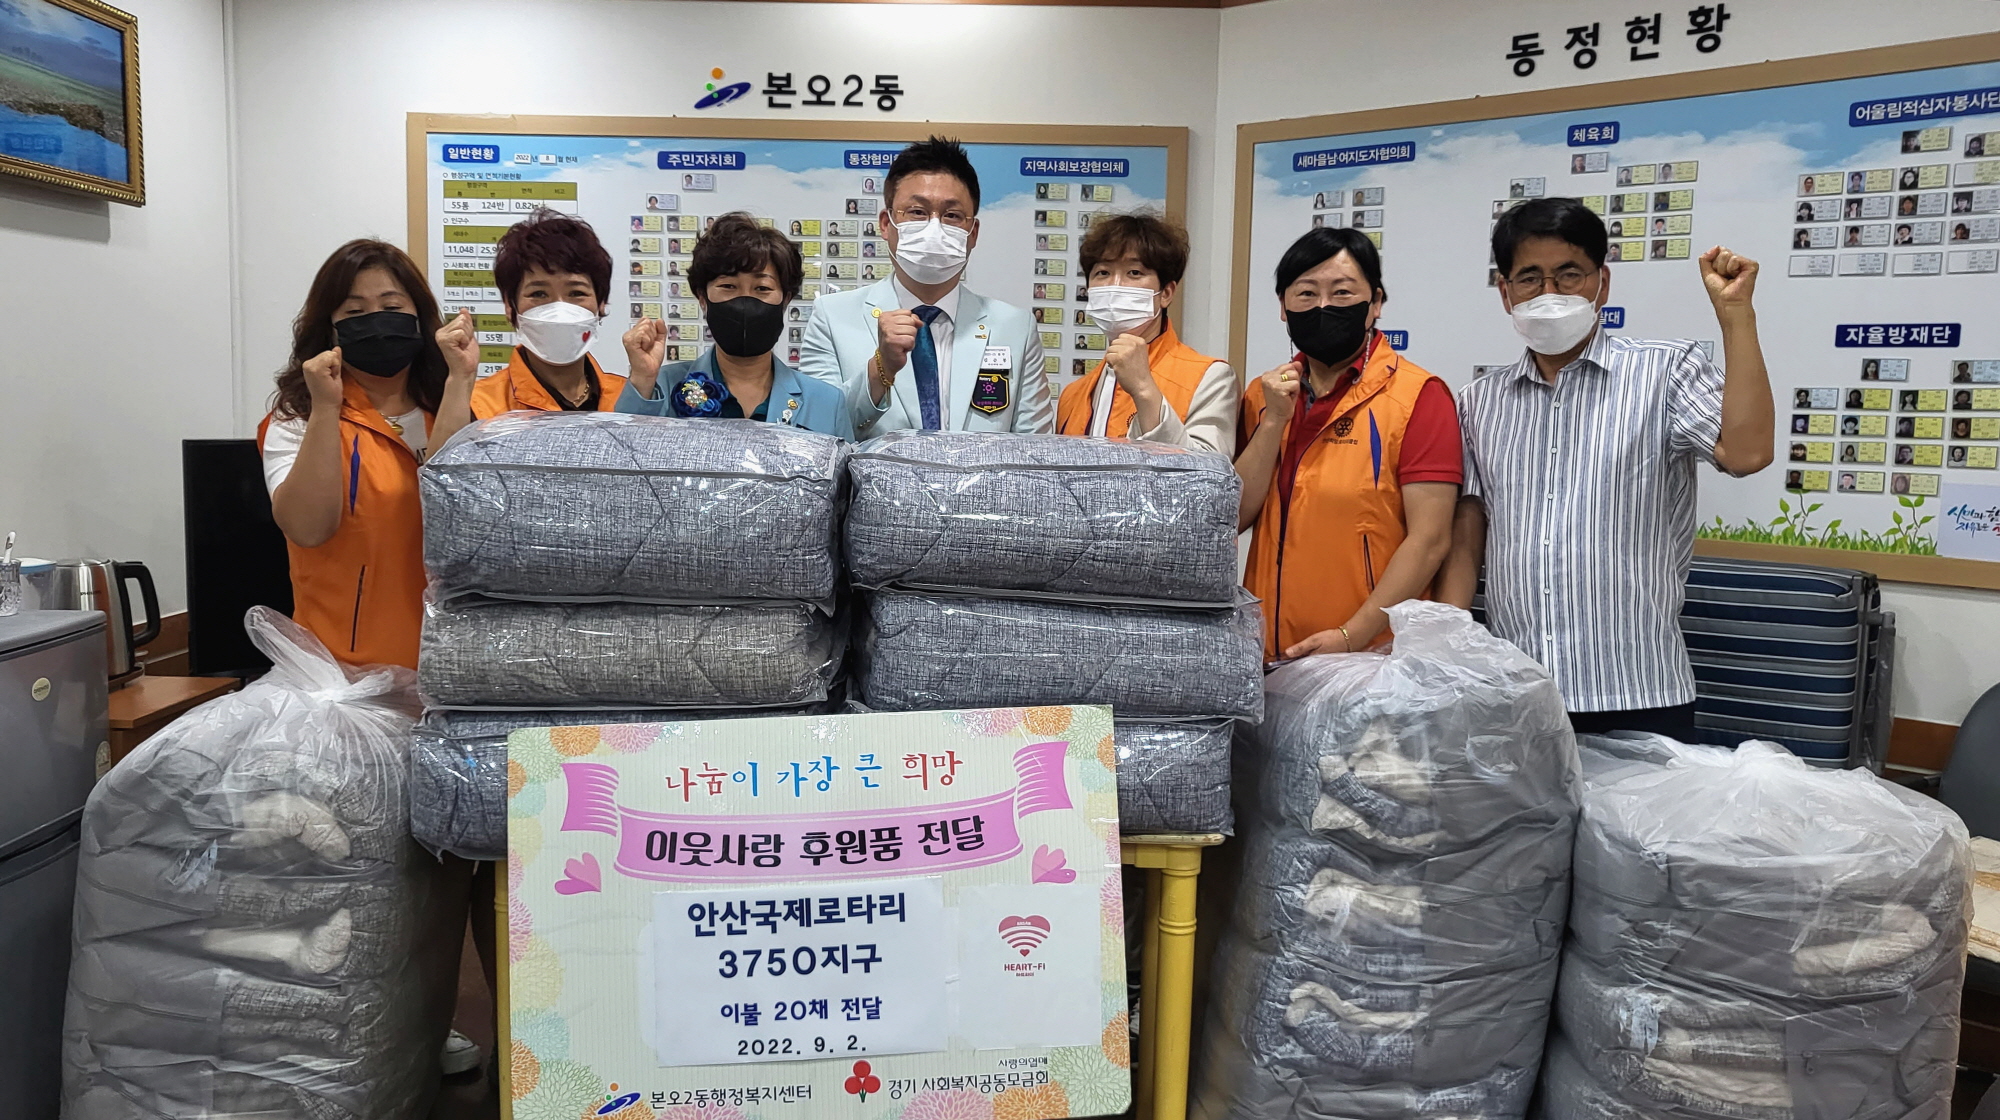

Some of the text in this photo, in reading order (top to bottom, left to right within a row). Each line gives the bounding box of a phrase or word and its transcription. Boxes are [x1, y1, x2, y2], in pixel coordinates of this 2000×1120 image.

[762, 72, 904, 111] 본오2동
[1855, 92, 2000, 121] 어울림적십자봉사단
[1572, 125, 1615, 143] 체육회
[448, 147, 495, 161] 일반현황
[532, 155, 538, 163] 년
[667, 153, 736, 167] 주민자치회
[1025, 160, 1124, 173] 지역사회보장협의체
[451, 201, 470, 211] 55통
[482, 201, 505, 211] 124반
[451, 217, 470, 225] 인구수
[448, 245, 475, 254] 11,048
[480, 246, 498, 255] 25,9
[478, 262, 490, 270] 현황
[486, 333, 503, 343] 55명
[1845, 326, 1952, 345] 자율방재단
[666, 750, 964, 802] 나눔이 가장 큰 희망
[645, 815, 986, 868] 이웃사랑 후원품 전달
[687, 892, 907, 937] 안산국제로타리
[718, 944, 883, 980] 3750지구
[1004, 963, 1046, 971] HEART-FI
[720, 997, 882, 1026] 이불 20채 전달
[737, 1034, 867, 1056] 2022. 9. 2.
[998, 1057, 1048, 1069] 사랑의열매
[888, 1070, 1050, 1099] 경기 사회복지공동모금회
[650, 1086, 812, 1109] 본오2동행정복지센터
